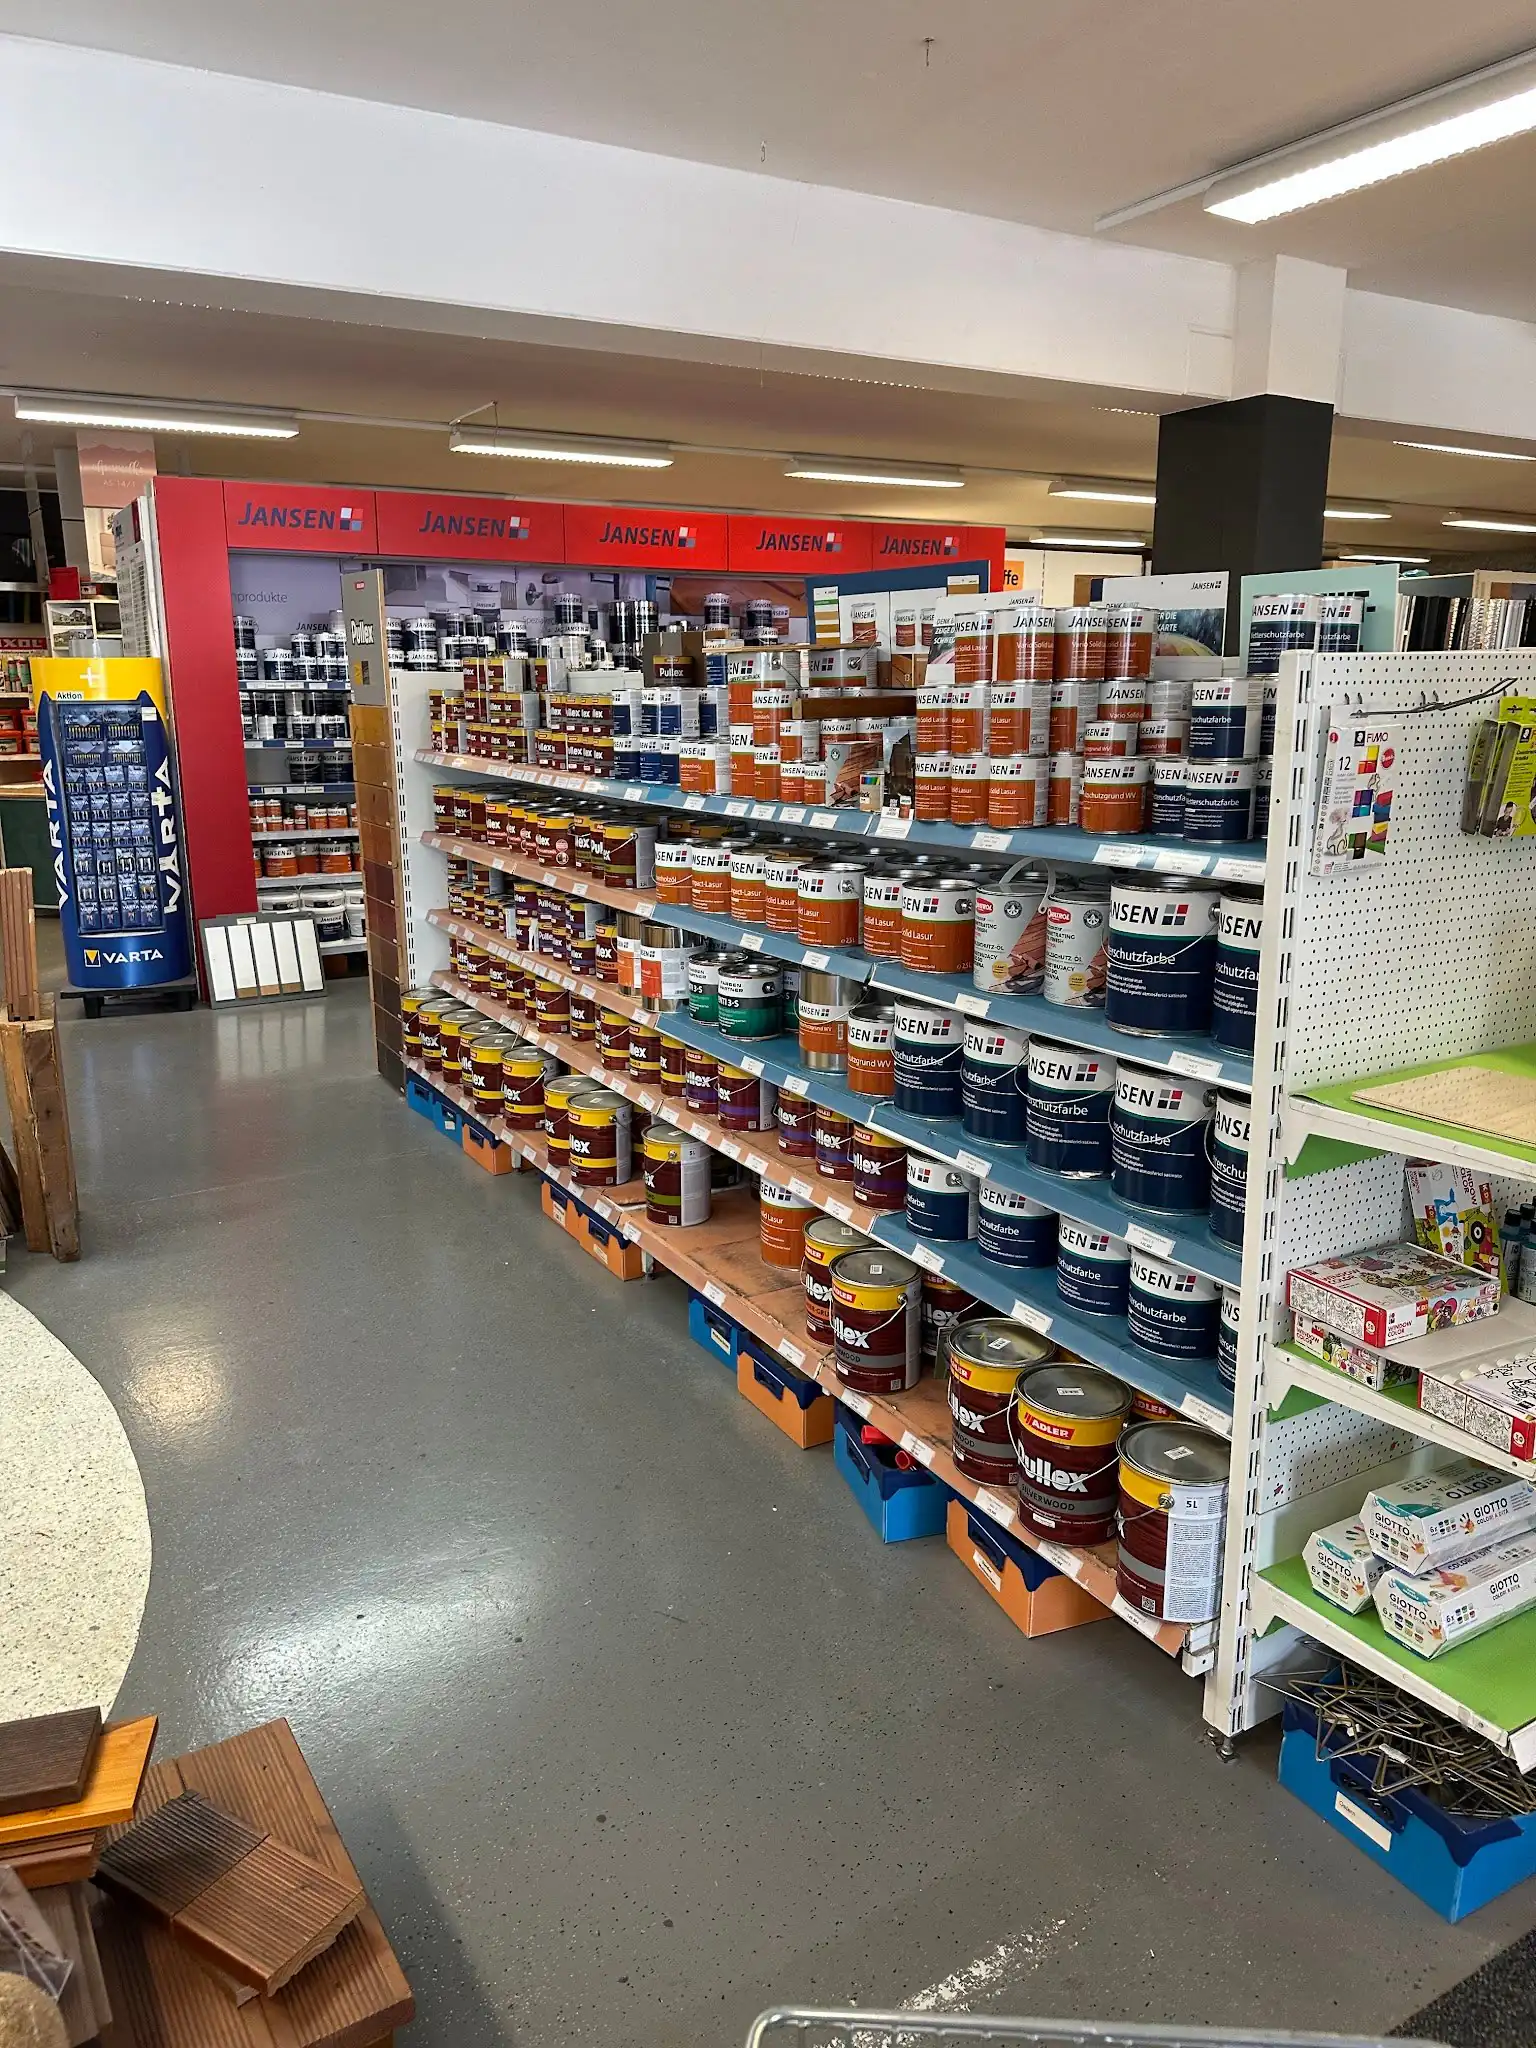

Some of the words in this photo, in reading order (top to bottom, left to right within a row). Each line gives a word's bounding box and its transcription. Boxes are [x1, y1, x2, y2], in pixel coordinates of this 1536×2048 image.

[238, 502, 336, 530] JANSEN
[418, 511, 506, 539] JANSEN
[599, 522, 675, 547] JANSEN
[756, 530, 823, 552] JANSEN
[880, 535, 942, 557] JANSEN
[1003, 569, 1019, 586] ffe
[1191, 581, 1215, 591] JANSEN
[1252, 604, 1289, 617] ANSEN
[296, 622, 329, 632] JANSEN
[659, 668, 684, 677] Pullex
[56, 691, 83, 700] Aktion
[1339, 756, 1351, 771] 12
[1125, 791, 1137, 799] WV
[42, 758, 69, 910] VARTA
[151, 755, 181, 915] VARTA
[777, 898, 796, 906] Lasur
[804, 909, 820, 917] Lasur
[874, 918, 895, 928] Lasur
[912, 931, 934, 941] Lasur
[103, 948, 164, 965] VARTA
[728, 999, 740, 1008] 3-S
[877, 1060, 892, 1069] WV
[1031, 1419, 1070, 1439] ADLER
[1017, 1438, 1089, 1493] Pullex
[1021, 1483, 1076, 1511] SILVERWOOD
[1446, 1476, 1502, 1499] GIOTTO
[1473, 1497, 1508, 1518] GIOTTO
[1375, 1512, 1410, 1536] GIOTTO
[1318, 1552, 1351, 1578] GIOTTO
[1489, 1573, 1520, 1595] GIOTTO
[1389, 1592, 1428, 1620] GIOTTO
